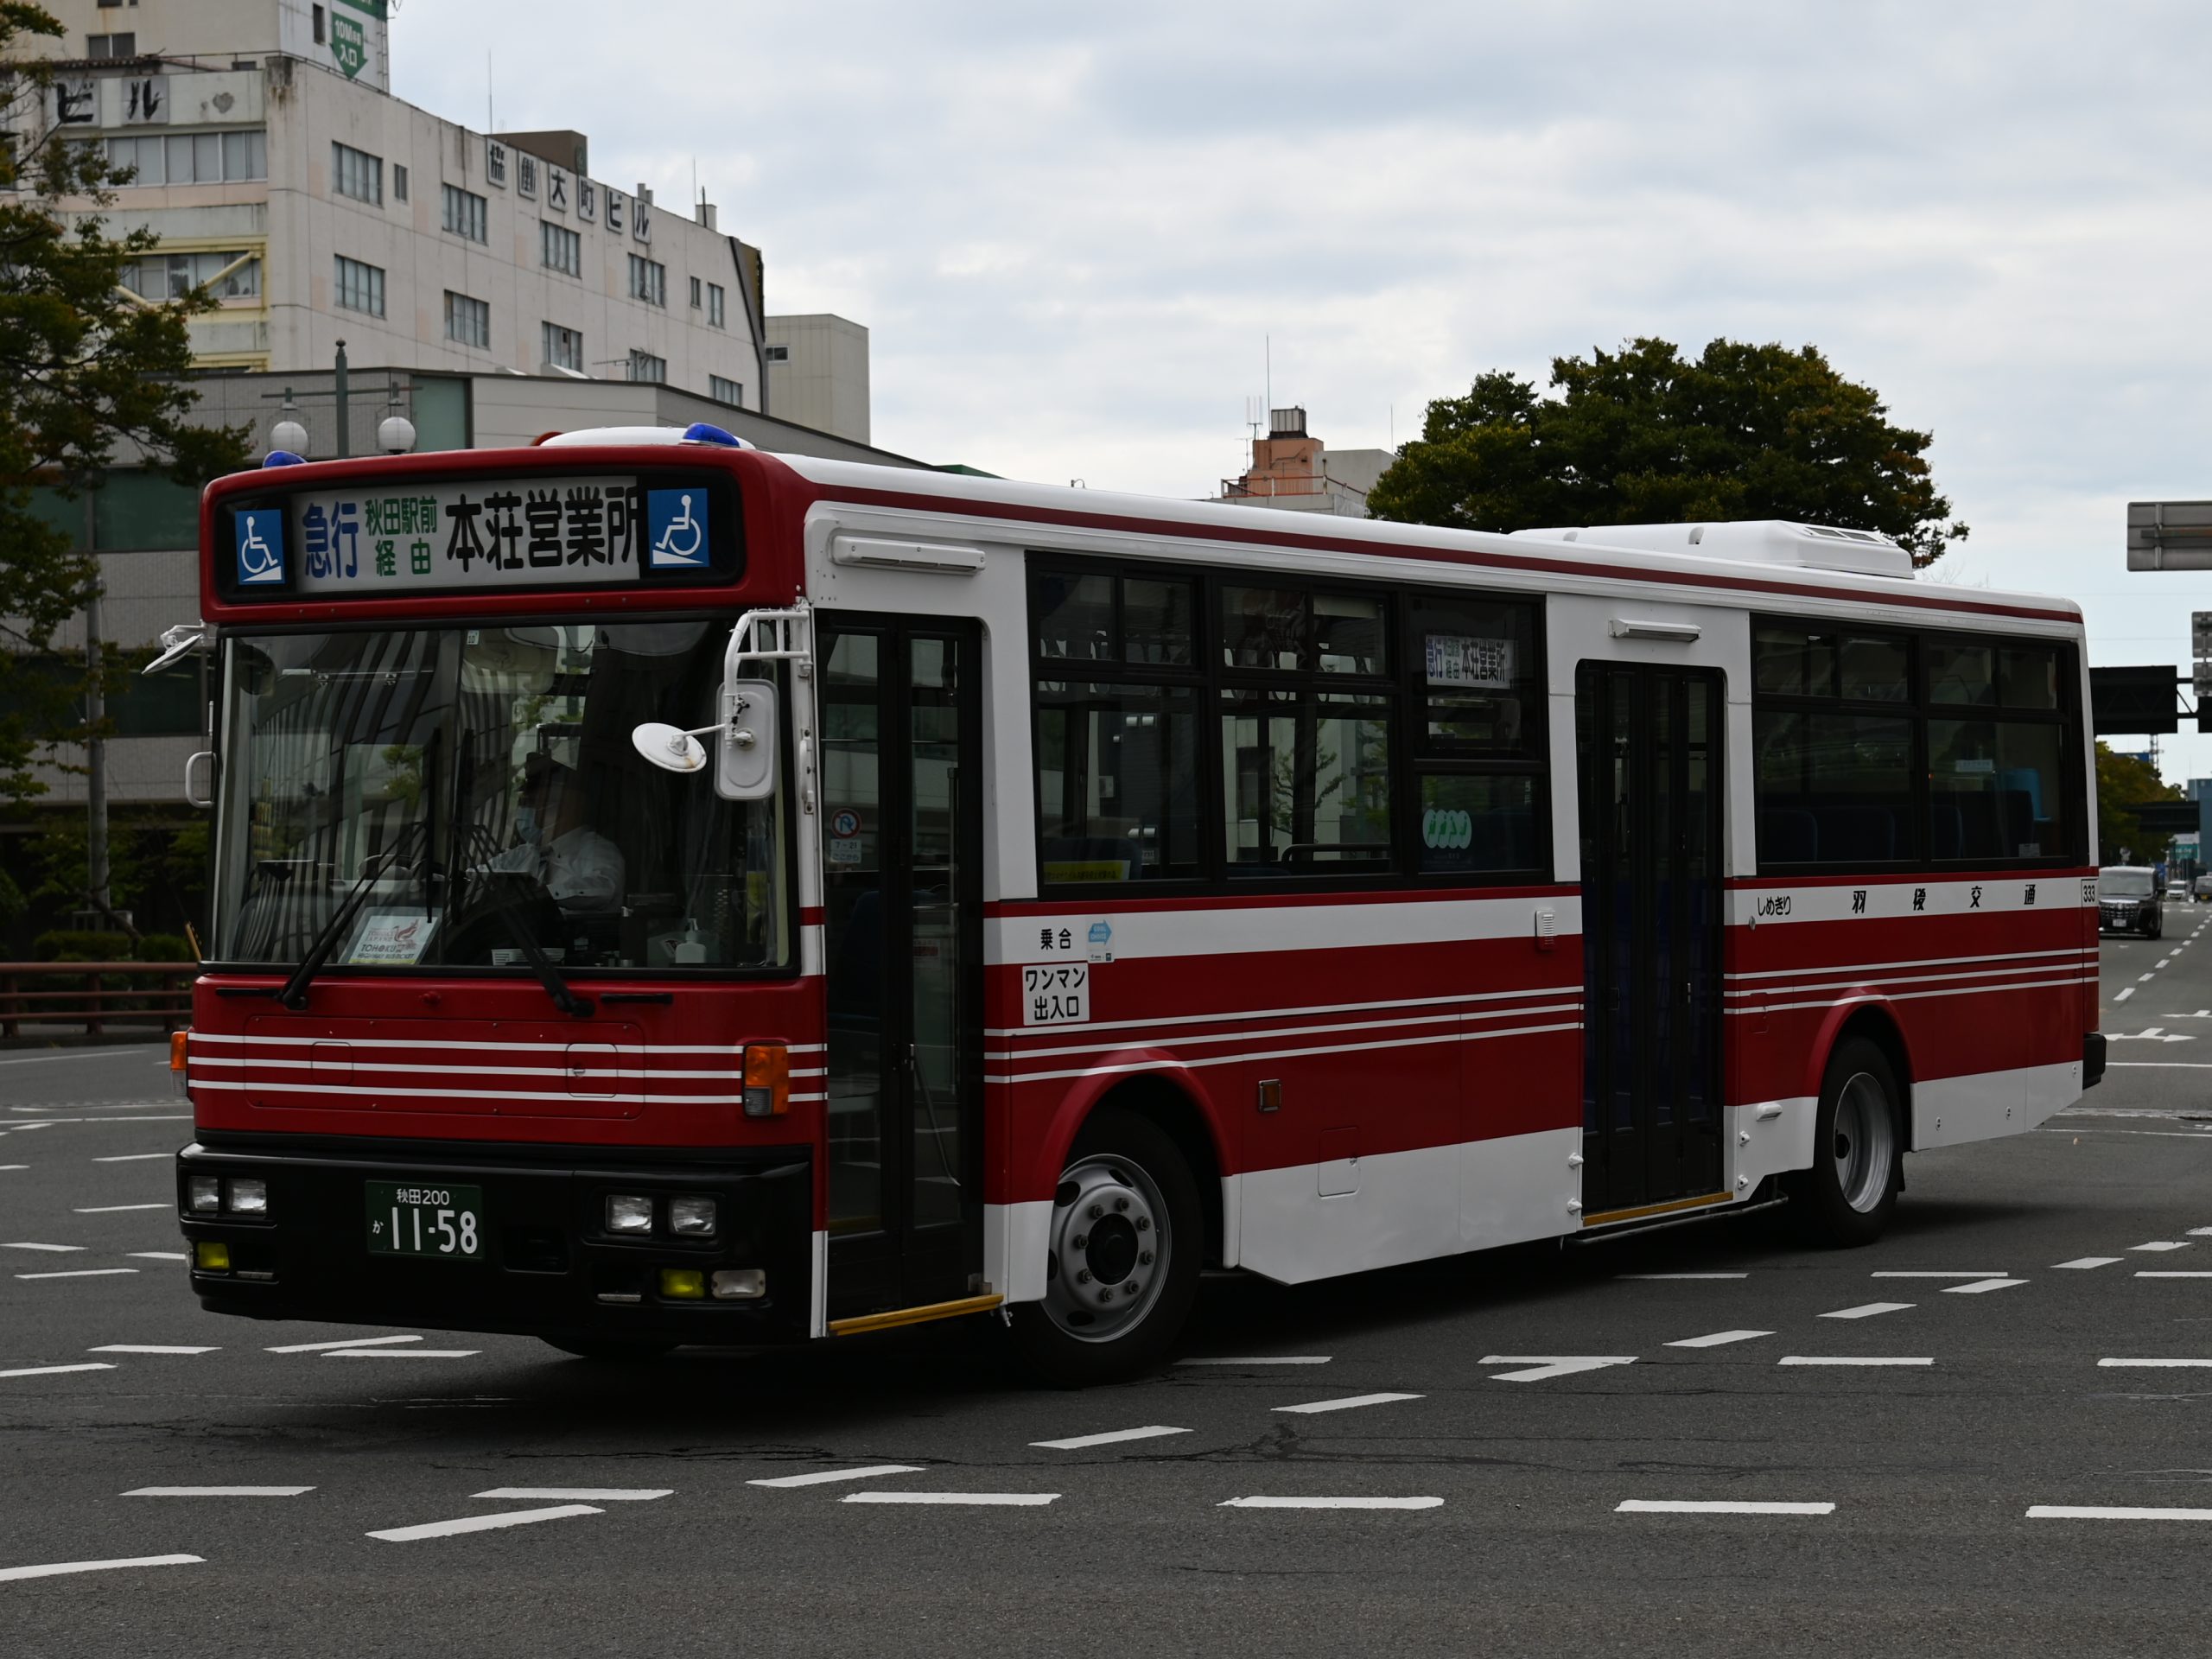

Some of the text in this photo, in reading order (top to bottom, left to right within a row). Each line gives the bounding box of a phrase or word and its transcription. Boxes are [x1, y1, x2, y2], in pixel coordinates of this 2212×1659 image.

[340, 44, 359, 68] 入口
[57, 79, 162, 123] ビル
[364, 493, 438, 537] 秋田駅前
[302, 500, 359, 579] 急行
[445, 485, 639, 574] 本荘営業所
[374, 537, 432, 577] 経由
[1757, 895, 1792, 917] しめきり
[1851, 884, 2037, 914] 羽後交通
[2082, 884, 2095, 903] 333
[1040, 927, 1072, 950] 乗合
[1025, 967, 1086, 992] ワンマン
[1034, 995, 1079, 1020] 出入口
[372, 1219, 385, 1234] か
[391, 1206, 478, 1255] 11-58
